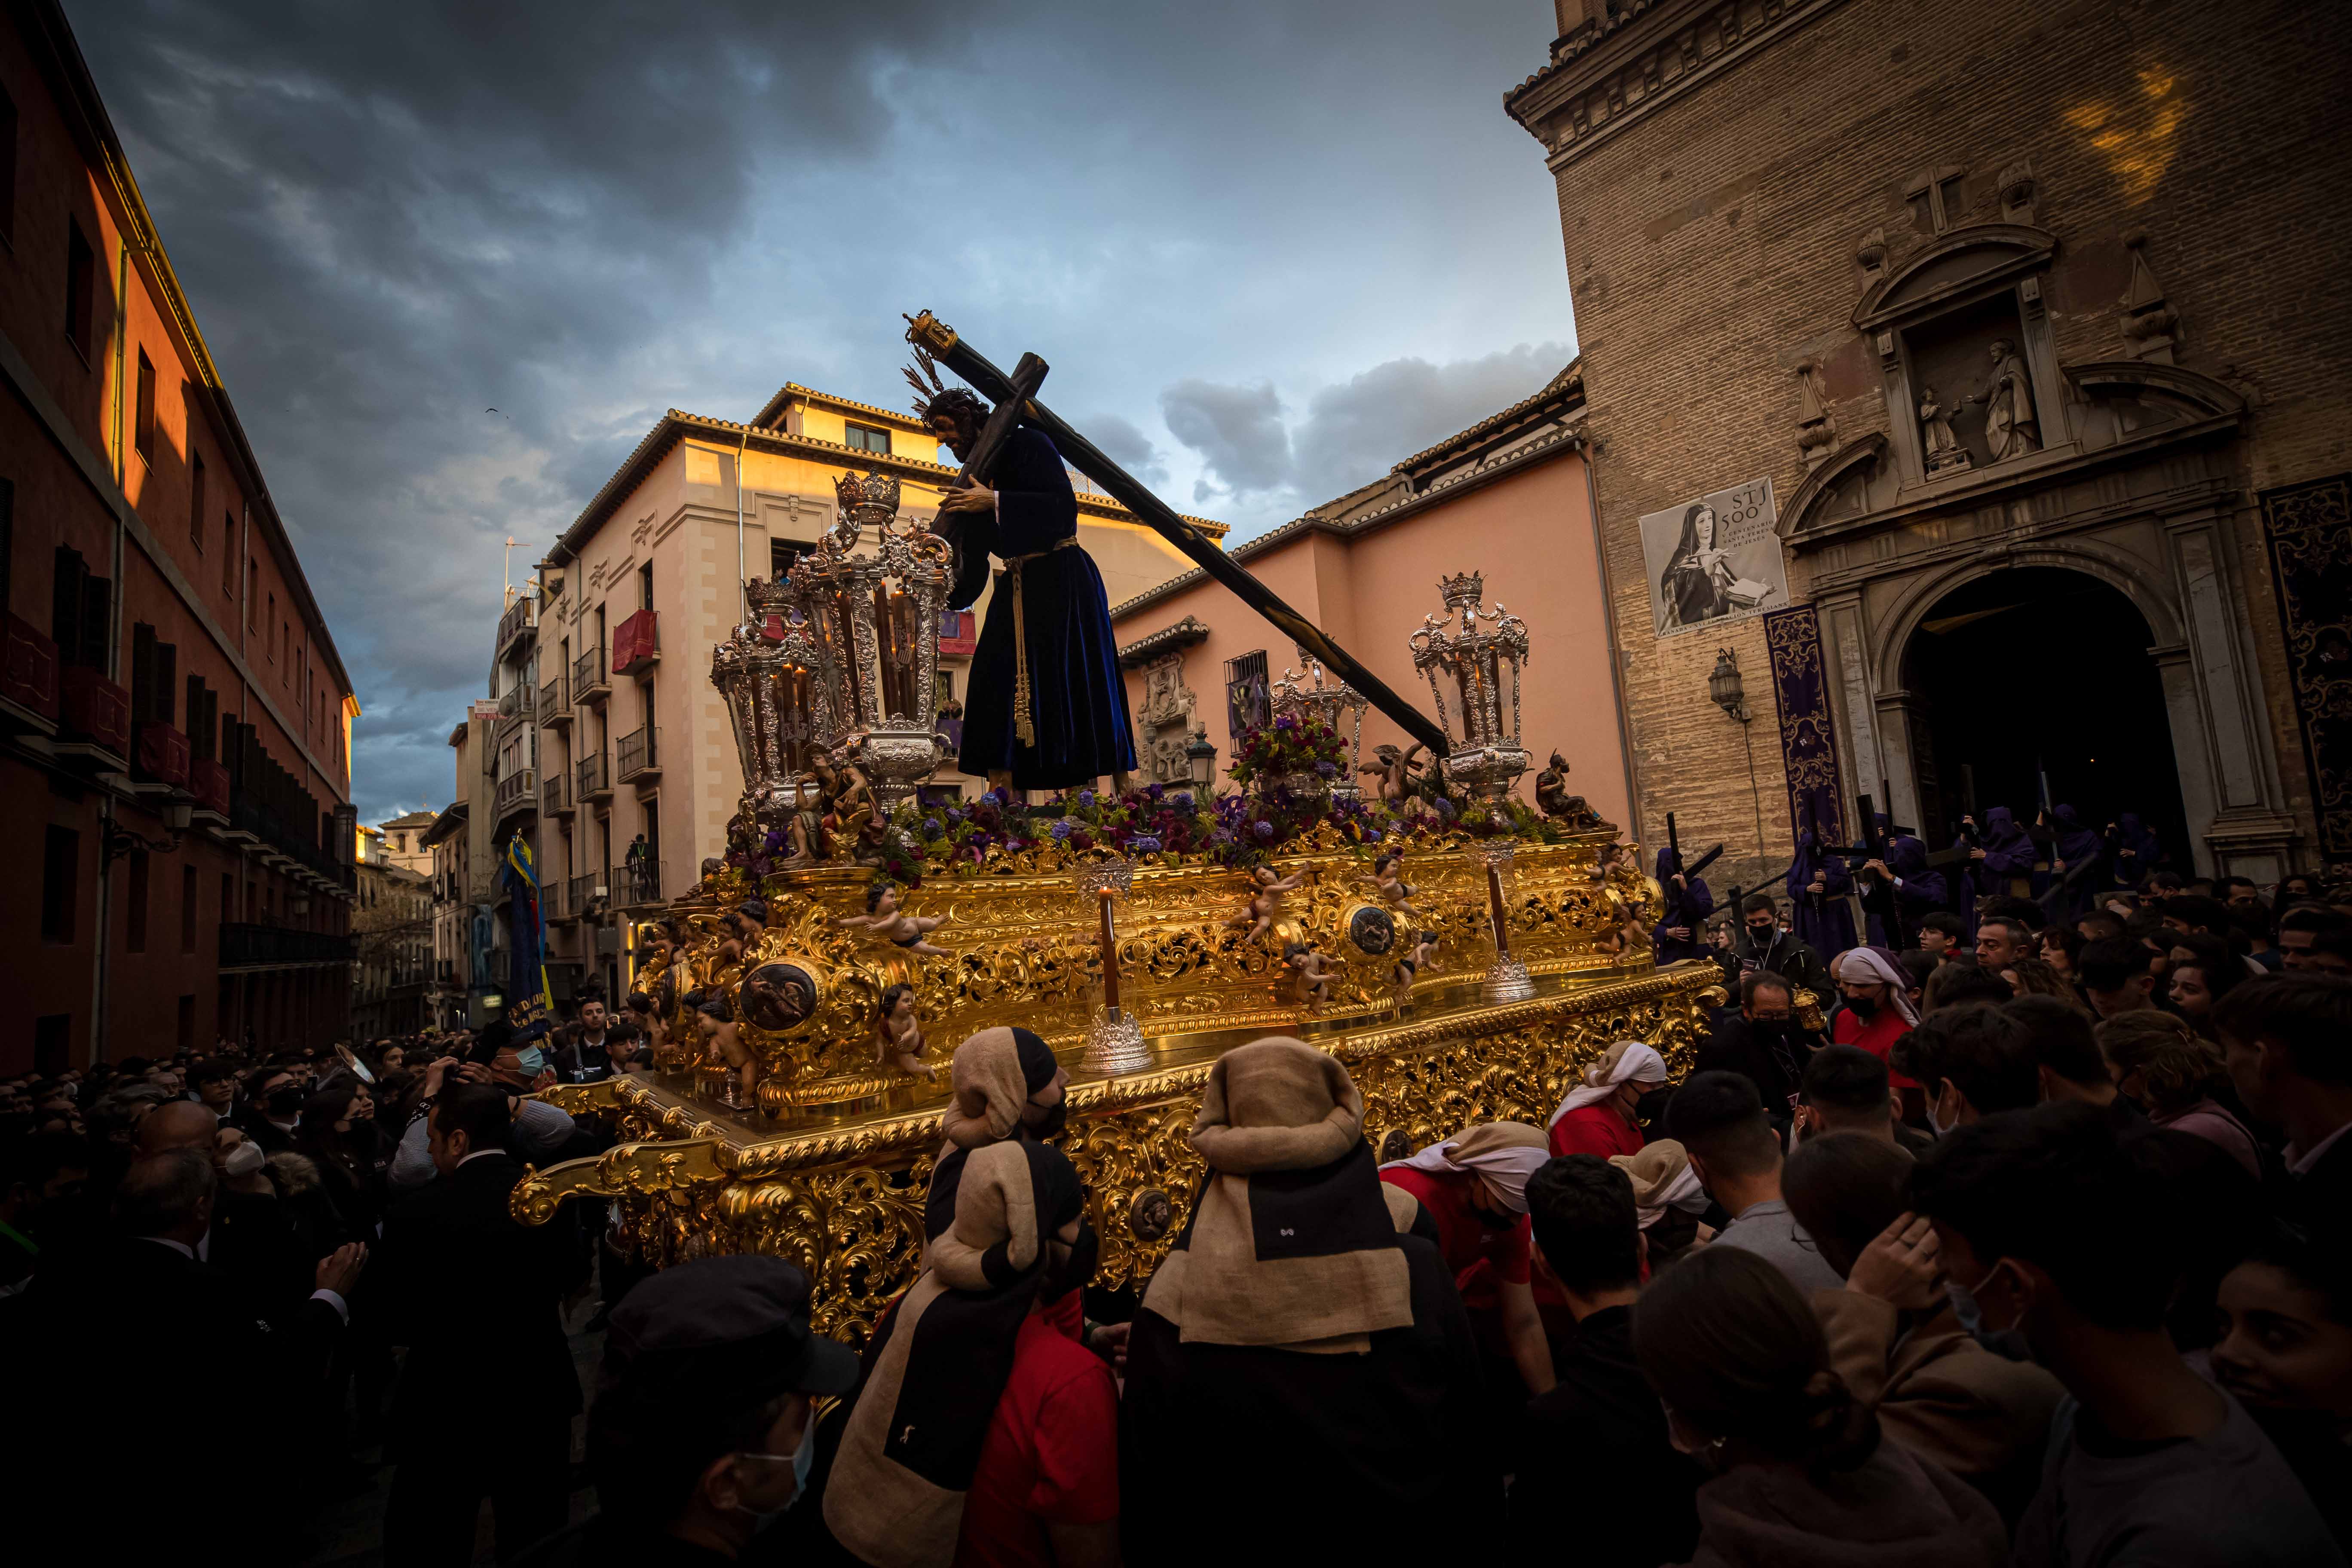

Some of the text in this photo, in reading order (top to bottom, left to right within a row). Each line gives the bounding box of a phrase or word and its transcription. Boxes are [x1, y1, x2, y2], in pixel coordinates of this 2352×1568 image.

[1722, 507, 1758, 531] 500
[1723, 527, 1774, 544] SANTA TERESA
[1728, 520, 1773, 536] CENTENARIO
[1749, 602, 1788, 615] TERESIANA
